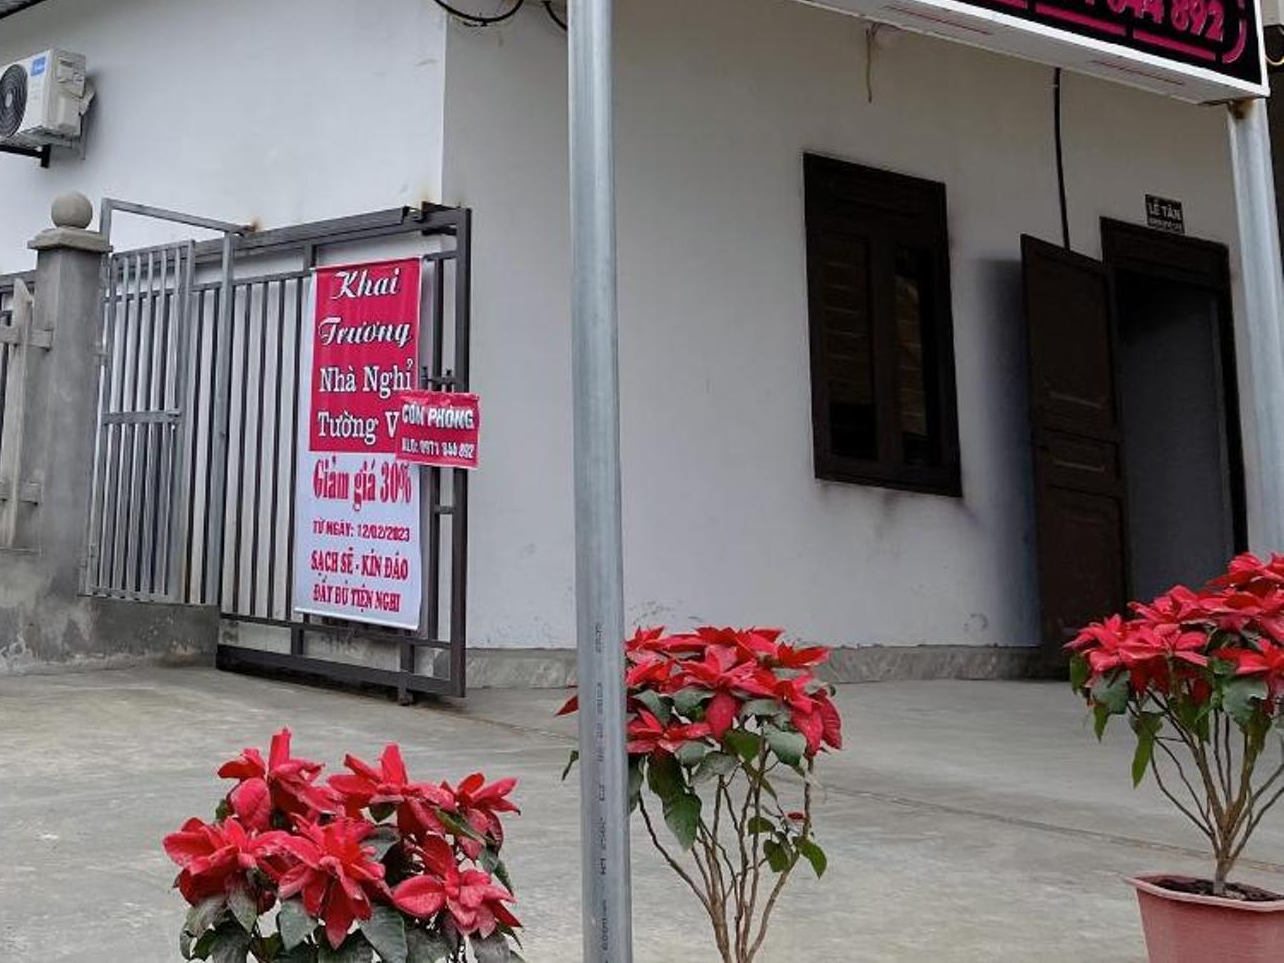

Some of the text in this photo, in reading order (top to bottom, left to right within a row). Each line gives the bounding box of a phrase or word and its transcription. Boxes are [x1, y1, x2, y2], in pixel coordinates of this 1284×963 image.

[331, 267, 400, 300] Khai
[319, 358, 414, 399] Nhà Nghỉ
[318, 409, 399, 445] Tường V
[427, 404, 474, 429] PHÒNG
[314, 455, 412, 512] Giảm giá 30%
[357, 523, 410, 542] 12/02/2023
[311, 549, 338, 576] SẠCH
[361, 549, 382, 577] KÍN
[383, 551, 409, 580] ĐÁO
[351, 583, 374, 613] TIỆN
[375, 591, 401, 612] NGHI
